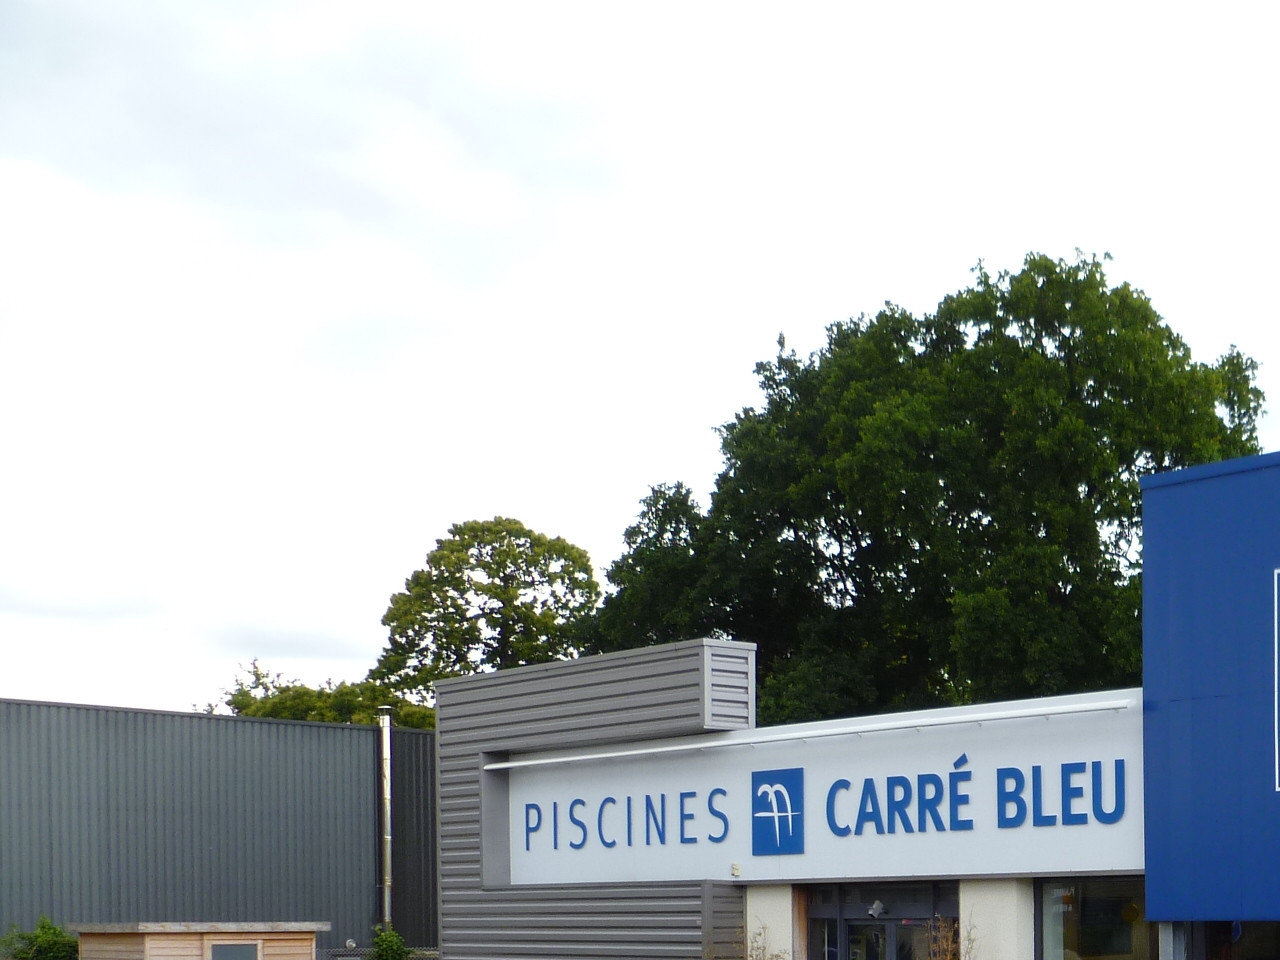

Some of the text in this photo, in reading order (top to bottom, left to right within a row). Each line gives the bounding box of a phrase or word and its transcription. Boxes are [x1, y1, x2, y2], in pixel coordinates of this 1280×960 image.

[524, 752, 1126, 852] PISCINES CARRÉ BLEU
